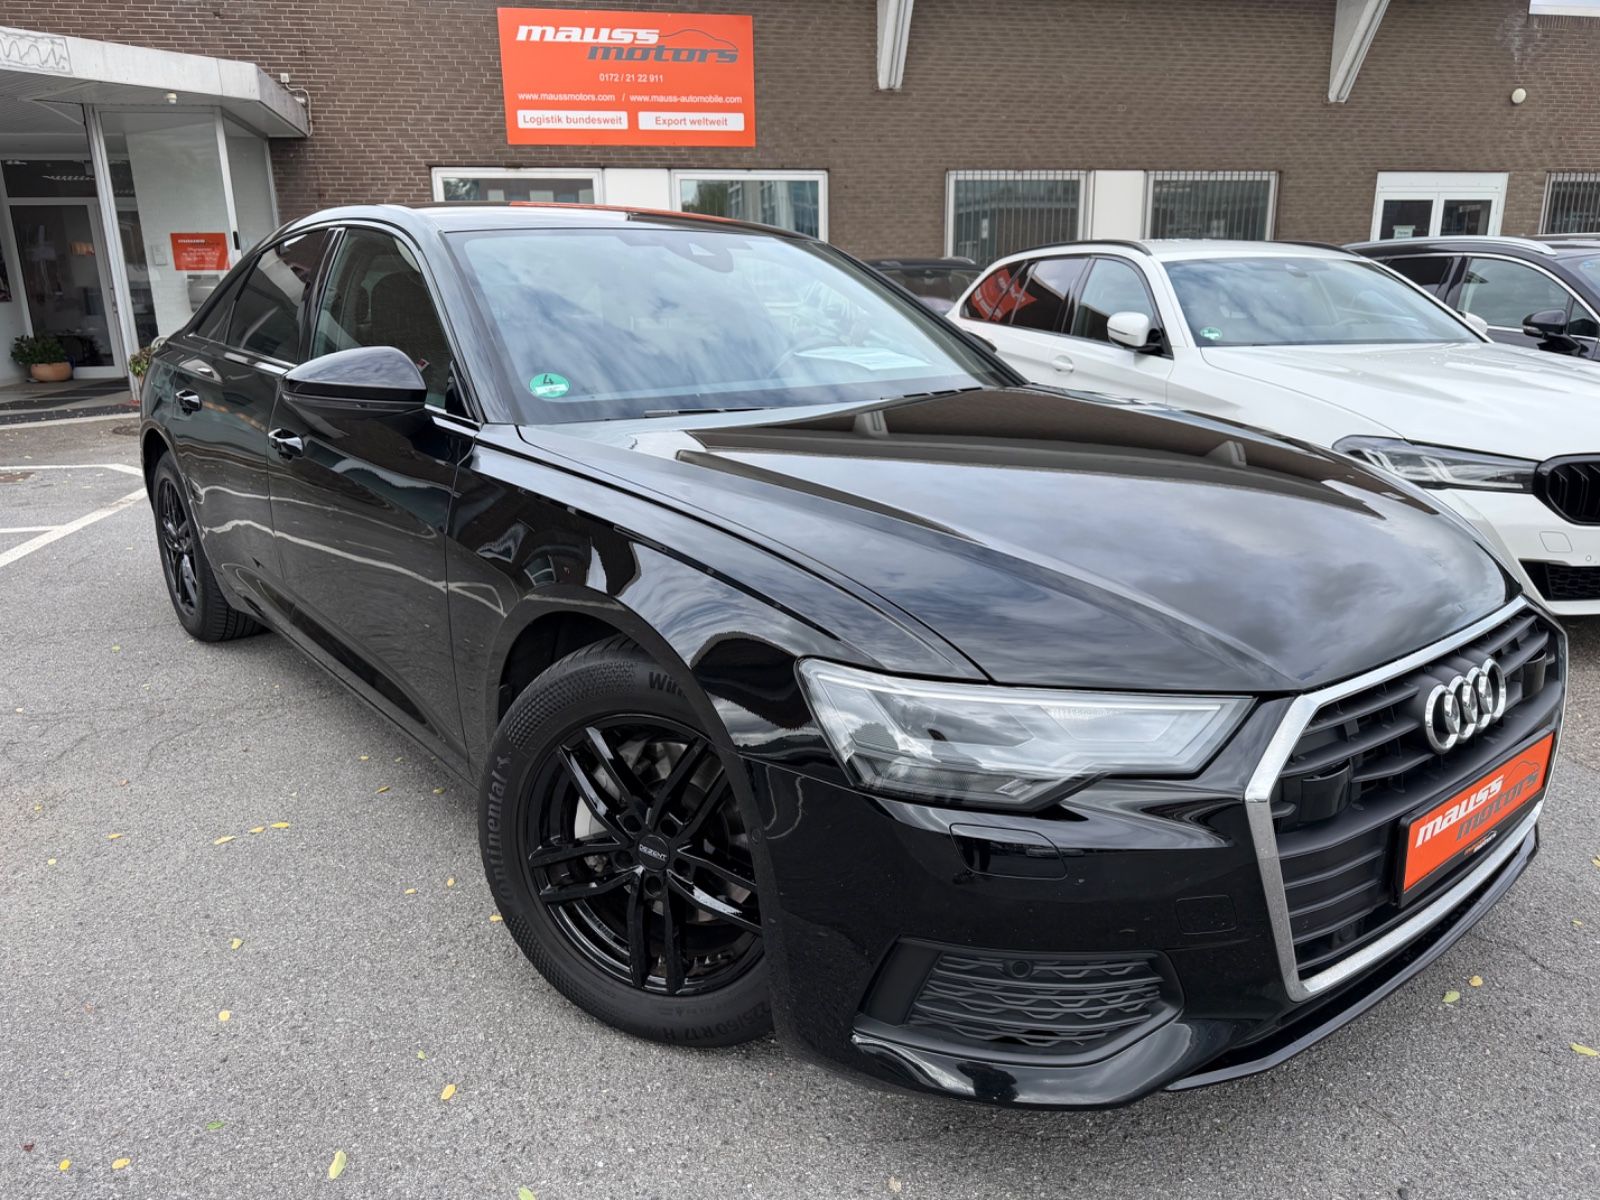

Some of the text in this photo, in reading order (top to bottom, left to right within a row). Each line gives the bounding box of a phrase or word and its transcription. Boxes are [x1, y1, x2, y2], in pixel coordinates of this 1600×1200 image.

[516, 25, 660, 45] mauss
[587, 45, 739, 64] motors
[599, 73, 620, 83] 0172
[626, 73, 635, 83] 21
[638, 74, 648, 83] 22
[649, 74, 664, 84] 911
[517, 92, 616, 103] www.maussmotors.com
[629, 94, 743, 105] www.mauss-automobile.com
[522, 115, 623, 127] Logistik bundesweit
[655, 116, 729, 128] Export weltweit
[1415, 774, 1504, 849] mauss
[1456, 768, 1540, 842] motors
